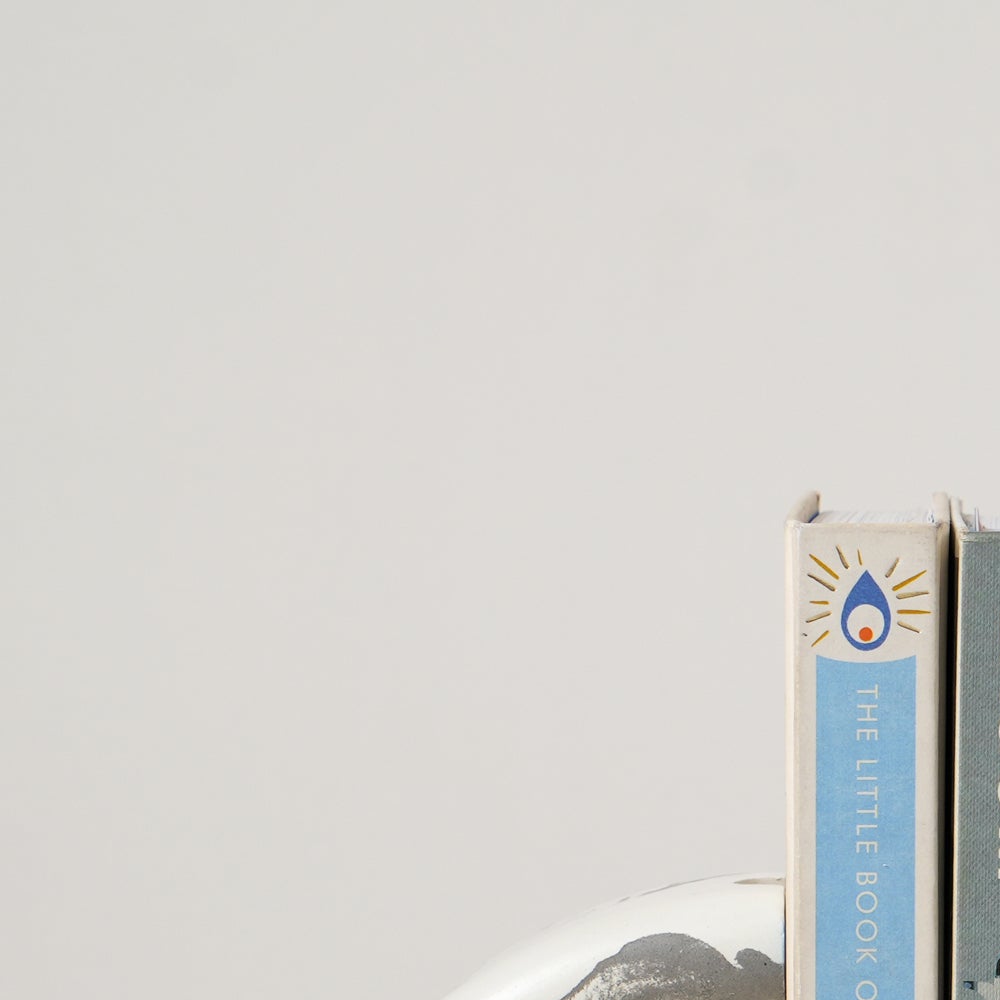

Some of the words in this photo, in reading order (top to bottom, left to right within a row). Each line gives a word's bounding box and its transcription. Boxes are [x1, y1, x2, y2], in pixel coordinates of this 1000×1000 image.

[855, 684, 879, 742] THE
[855, 758, 879, 855] LITTLE
[855, 872, 879, 964] BOOK
